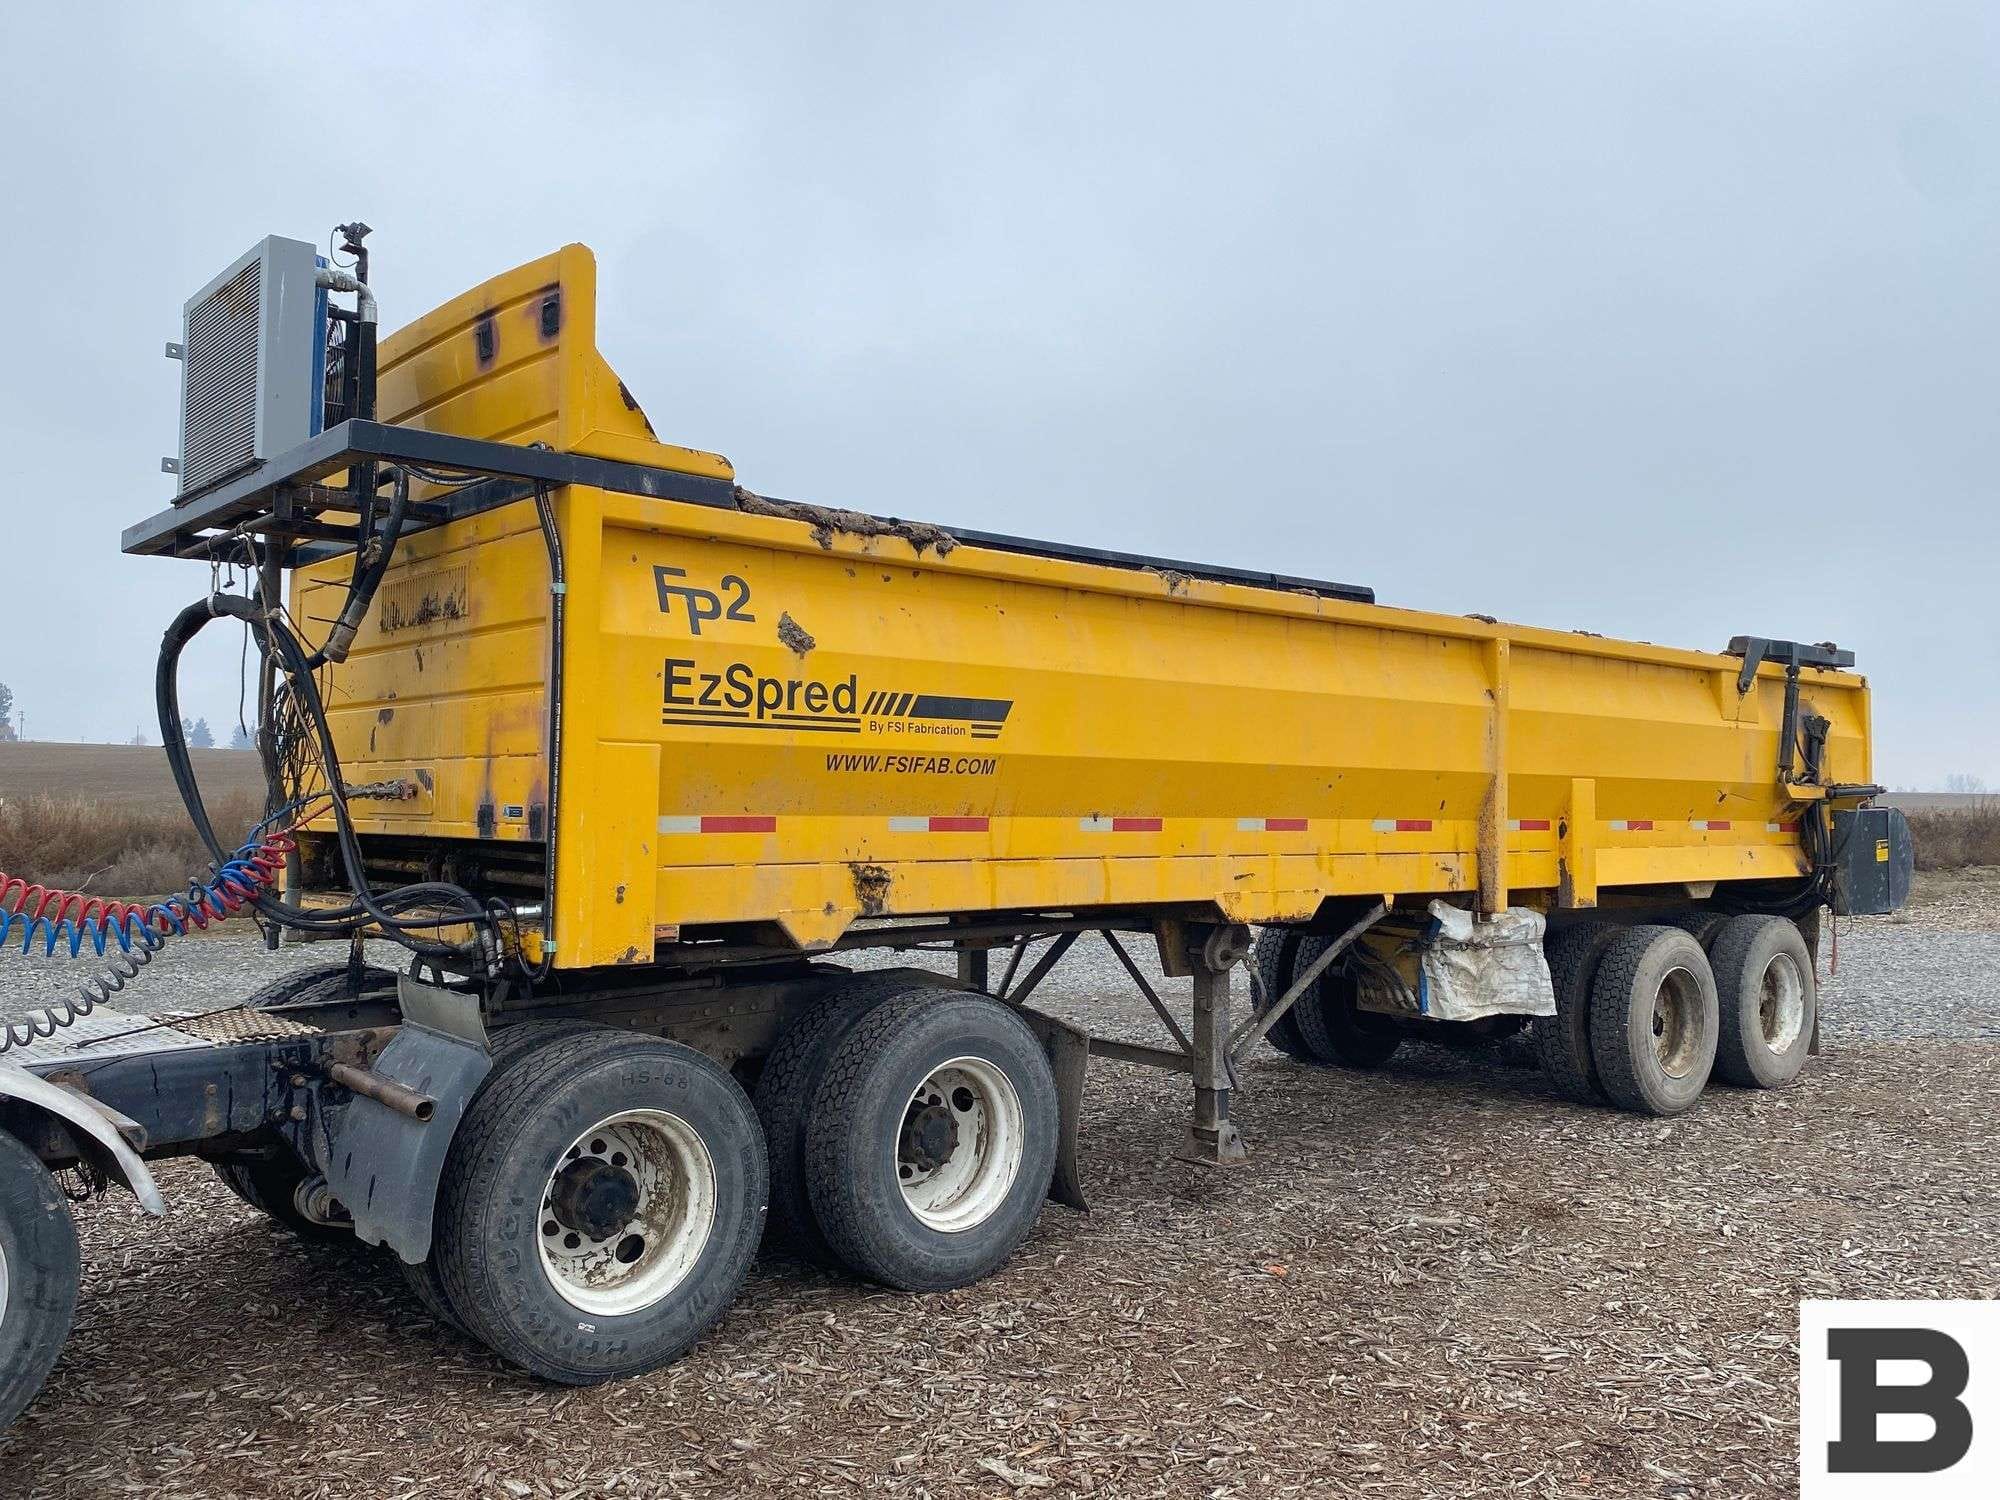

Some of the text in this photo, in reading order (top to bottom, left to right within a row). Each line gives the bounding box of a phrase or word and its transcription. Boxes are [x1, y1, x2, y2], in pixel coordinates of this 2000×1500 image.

[663, 658, 857, 720] EzSpred
[869, 720, 966, 736] By FSI Fabrication
[825, 753, 997, 776] WWW.FSIFAB.COM
